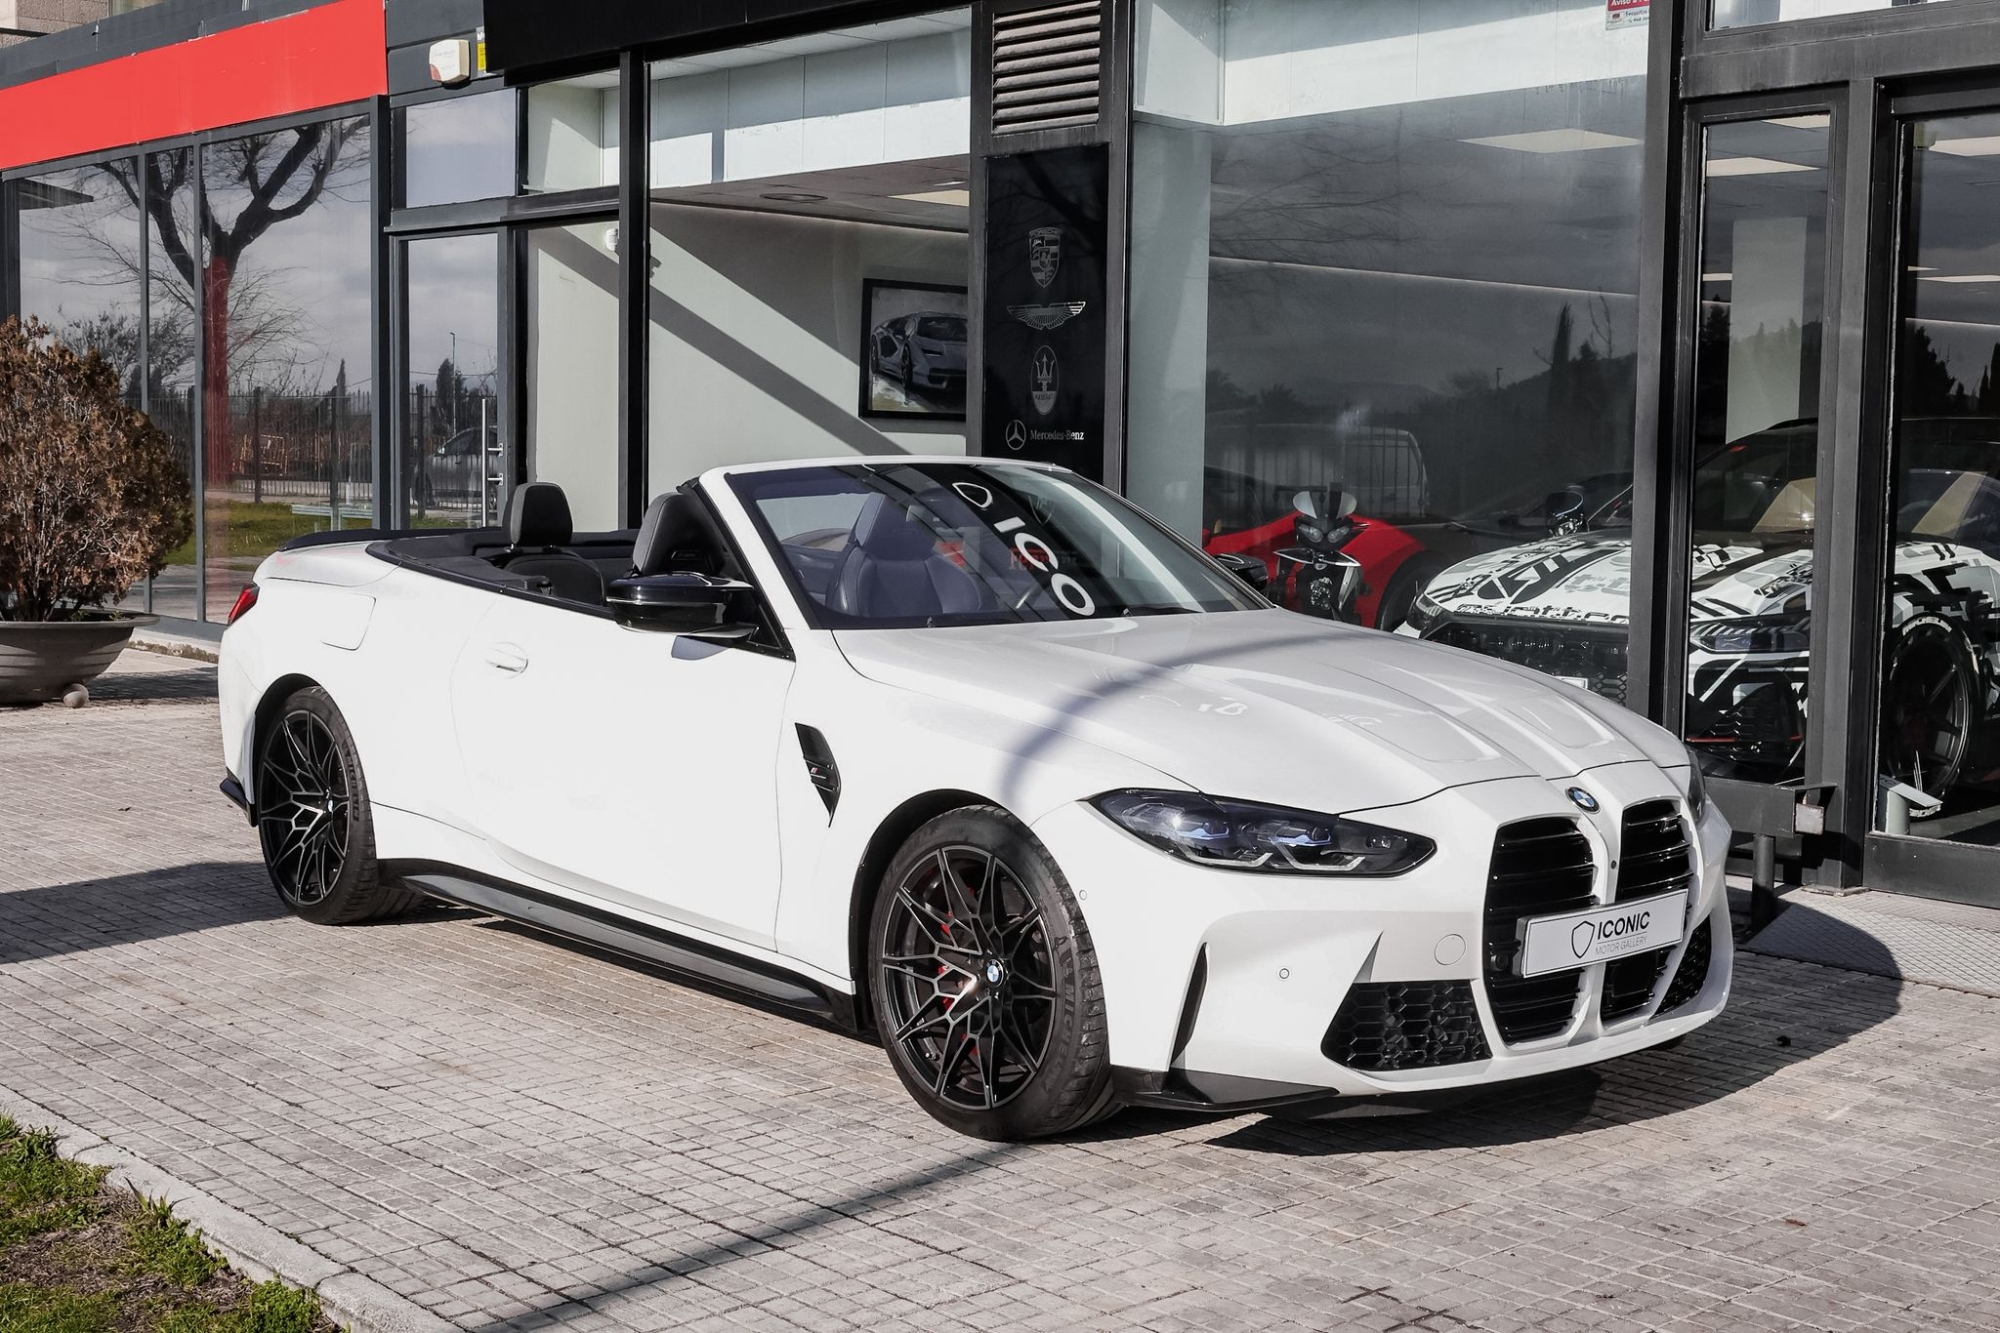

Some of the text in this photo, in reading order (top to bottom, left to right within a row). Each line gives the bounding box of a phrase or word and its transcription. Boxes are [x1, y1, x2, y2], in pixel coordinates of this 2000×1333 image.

[1030, 430, 1084, 440] Mercedes-Benz
[1597, 911, 1650, 940] ICONIC
[1595, 936, 1647, 955] MOTOR GALLERY
